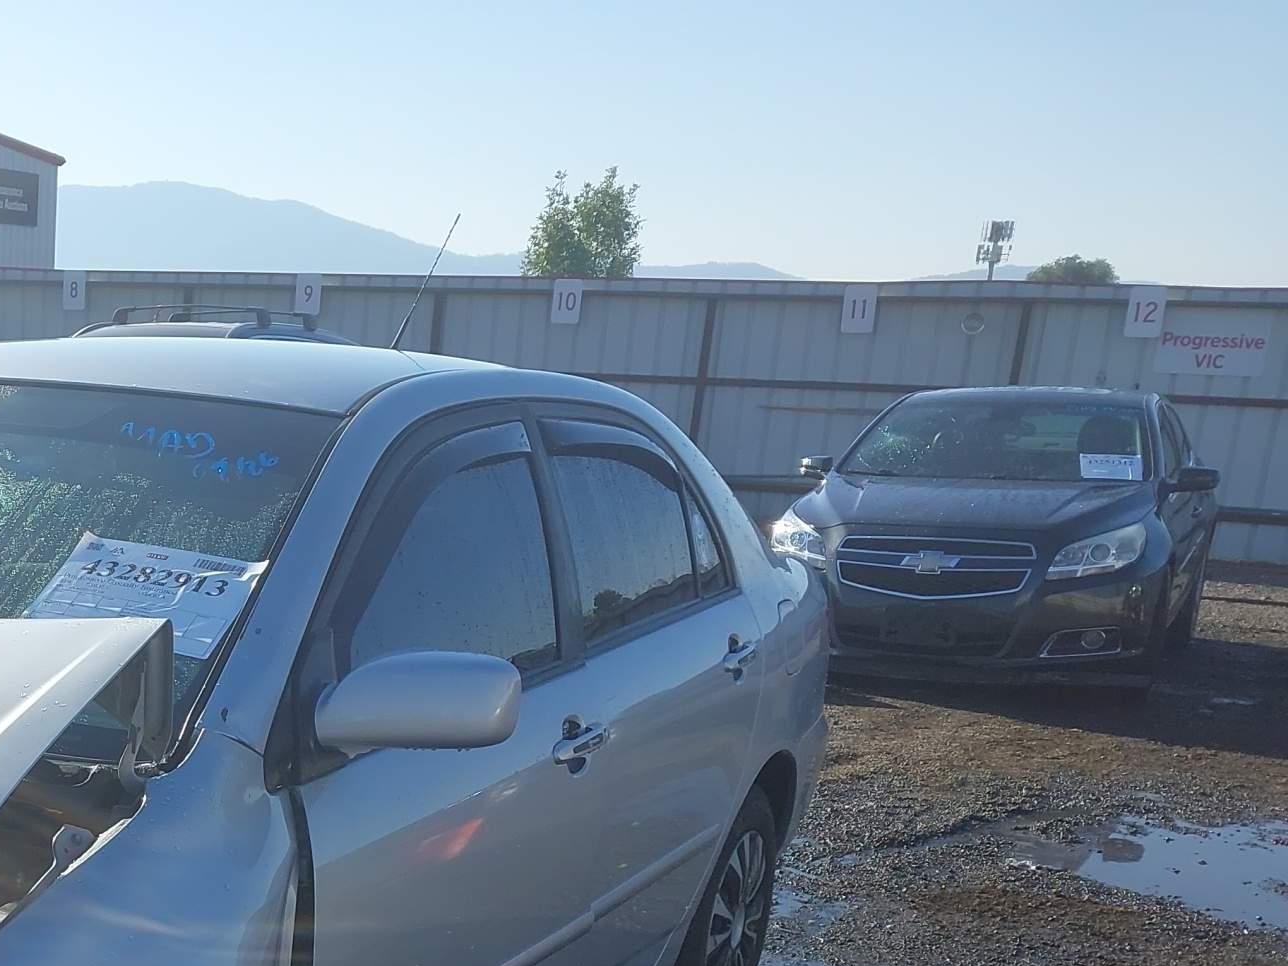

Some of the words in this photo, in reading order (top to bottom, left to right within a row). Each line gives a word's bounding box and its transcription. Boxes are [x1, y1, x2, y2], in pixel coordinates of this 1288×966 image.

[70, 281, 78, 298] 8
[304, 285, 313, 303] 9
[558, 292, 577, 312] 10
[851, 299, 867, 320] 11
[1133, 301, 1159, 323] 12
[1162, 331, 1266, 350] Progressive
[1194, 353, 1226, 369] VIC
[81, 559, 229, 597] 43282913
